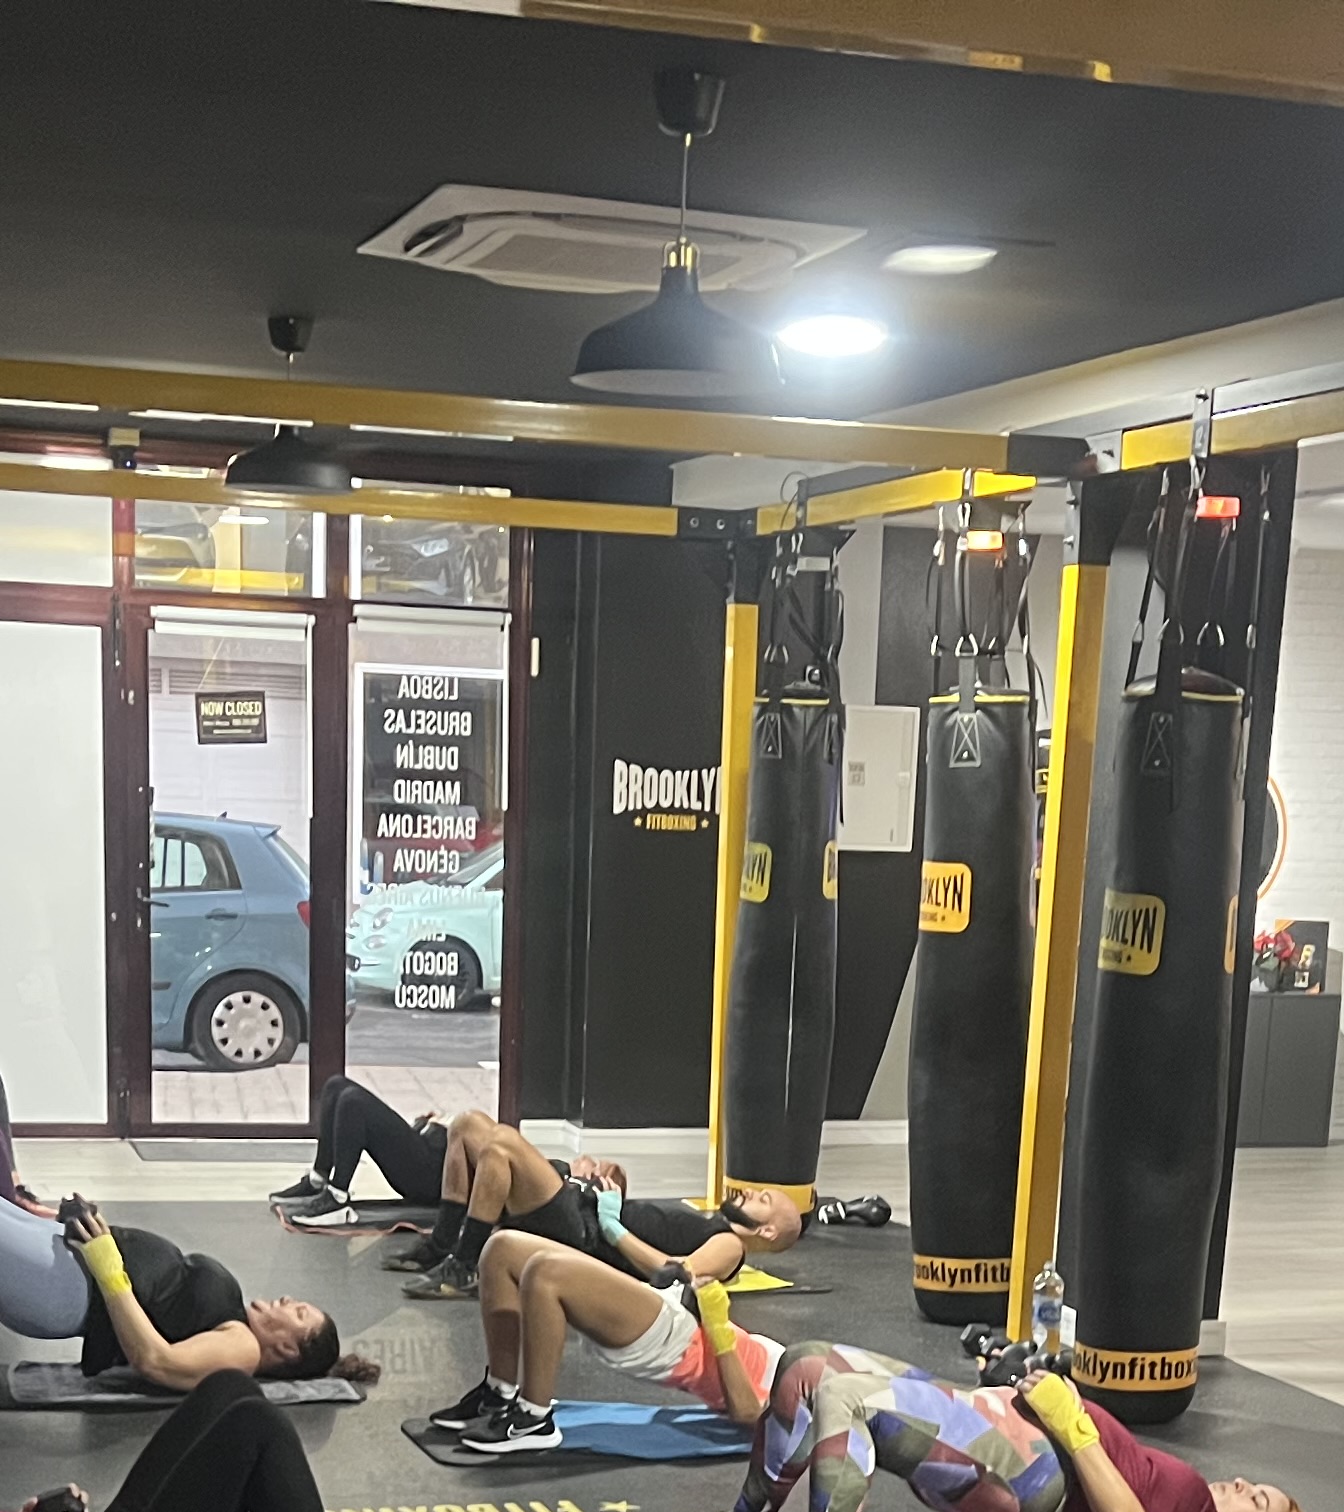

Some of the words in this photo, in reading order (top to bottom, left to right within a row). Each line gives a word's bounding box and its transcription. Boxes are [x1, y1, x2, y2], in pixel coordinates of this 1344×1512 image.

[201, 701, 224, 716] NOW
[225, 701, 262, 716] CLOSED
[646, 813, 696, 831] FITBOXING
